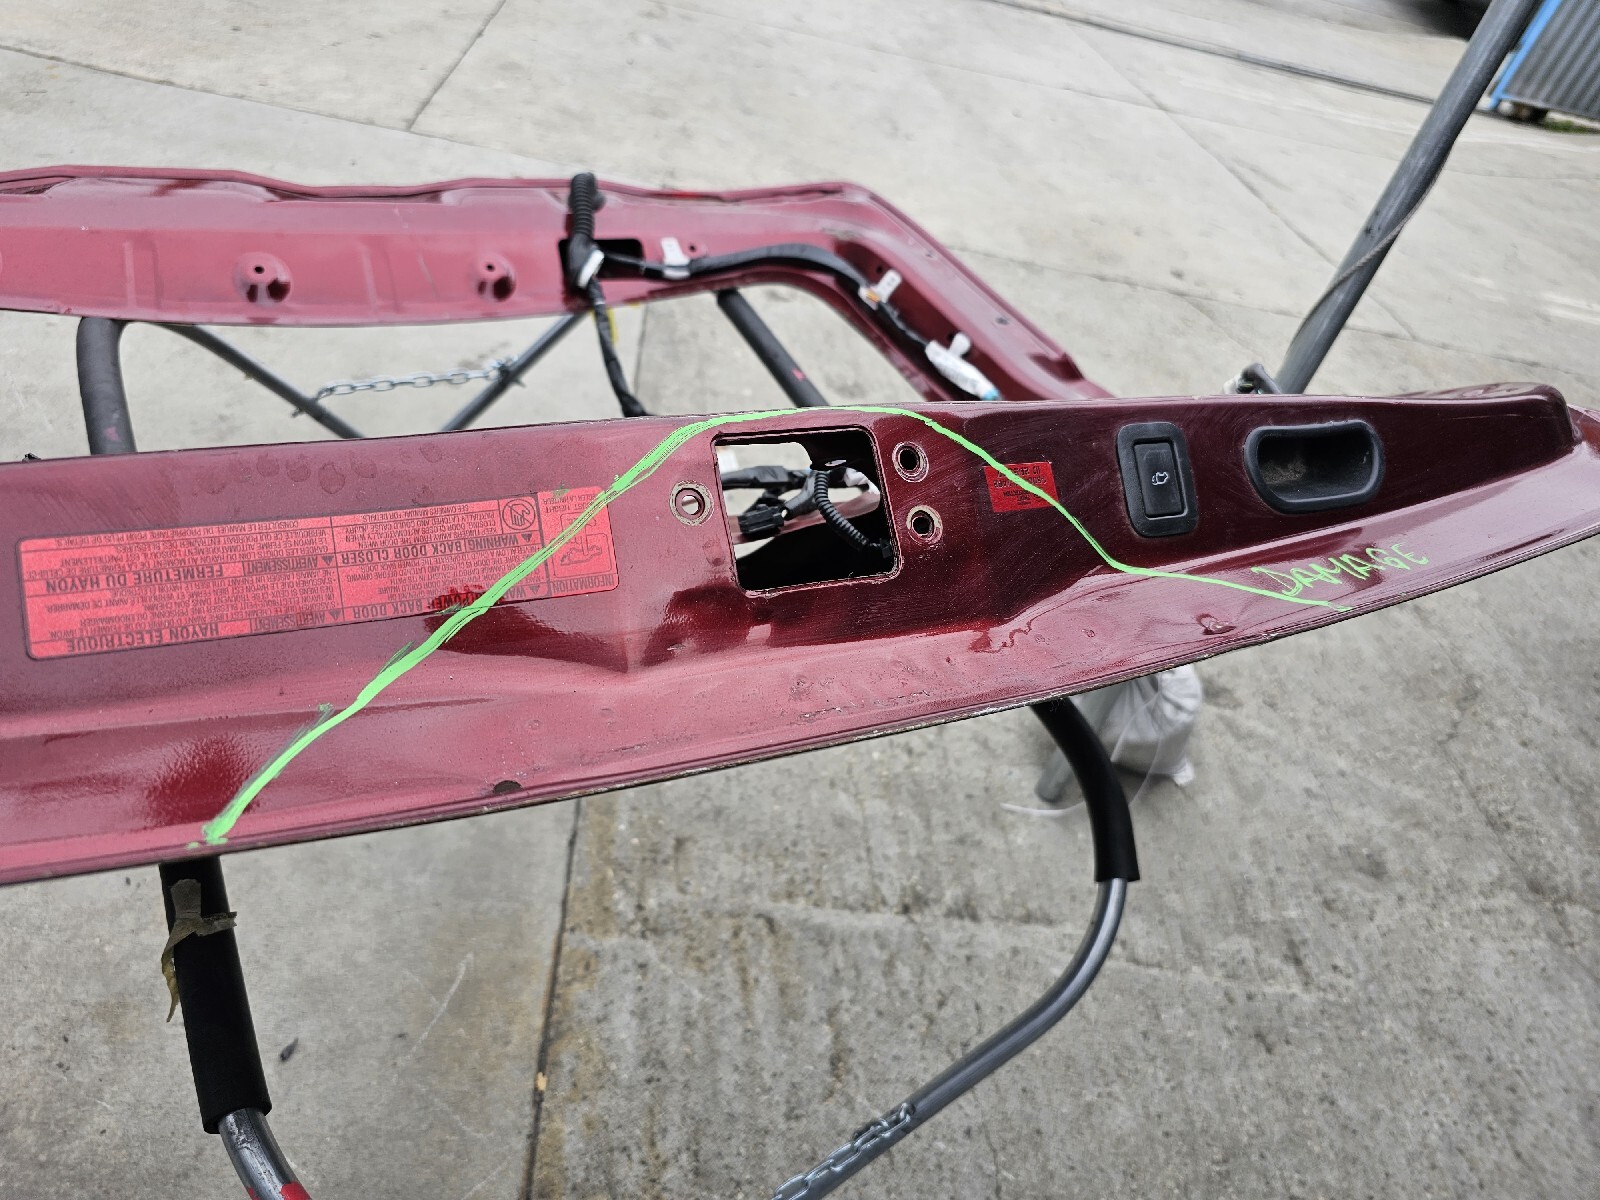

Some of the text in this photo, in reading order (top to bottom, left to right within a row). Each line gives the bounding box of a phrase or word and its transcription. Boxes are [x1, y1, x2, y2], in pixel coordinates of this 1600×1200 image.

[340, 534, 518, 564] WARNING BACK DOOR CLOSER
[45, 555, 318, 594] AVERTISSEMENT FERMETURE DU HAYON
[552, 574, 613, 593] INFORMATION
[1251, 544, 1430, 596] DAMAGE
[352, 603, 386, 619] DOOR
[392, 599, 422, 614] BACK
[66, 610, 326, 654] AVERTISSEMENT HAYON ÉLECTRIQUE
